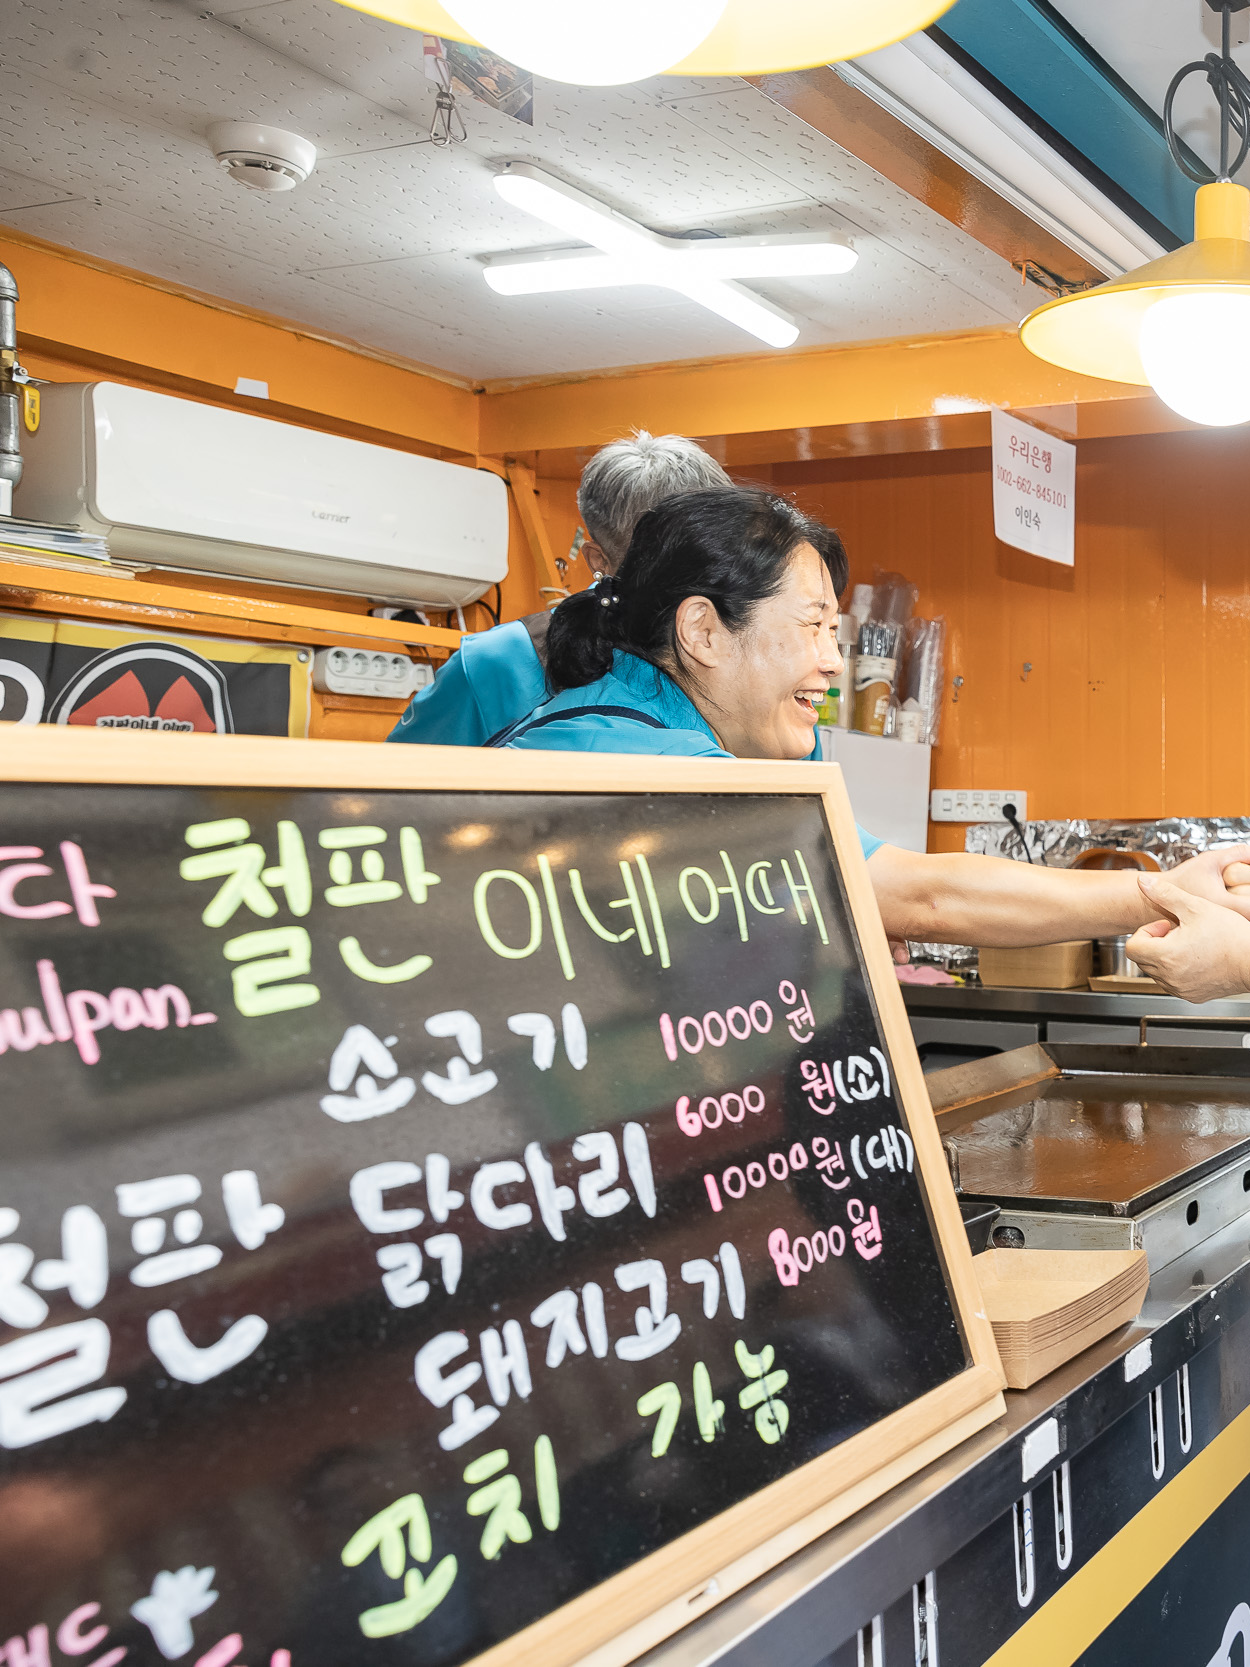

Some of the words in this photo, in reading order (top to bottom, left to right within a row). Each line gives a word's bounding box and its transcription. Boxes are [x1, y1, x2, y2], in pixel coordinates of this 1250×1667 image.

[1008, 435, 1053, 474] 우리은행
[311, 508, 351, 523] Carrier
[1014, 505, 1042, 531] 이인숙
[319, 1002, 588, 1123] 소고기
[349, 1121, 657, 1309] 닭다리
[414, 1242, 746, 1451] 돼지고기
[341, 1434, 560, 1639] 꼬치
[637, 1339, 790, 1458] 가능
